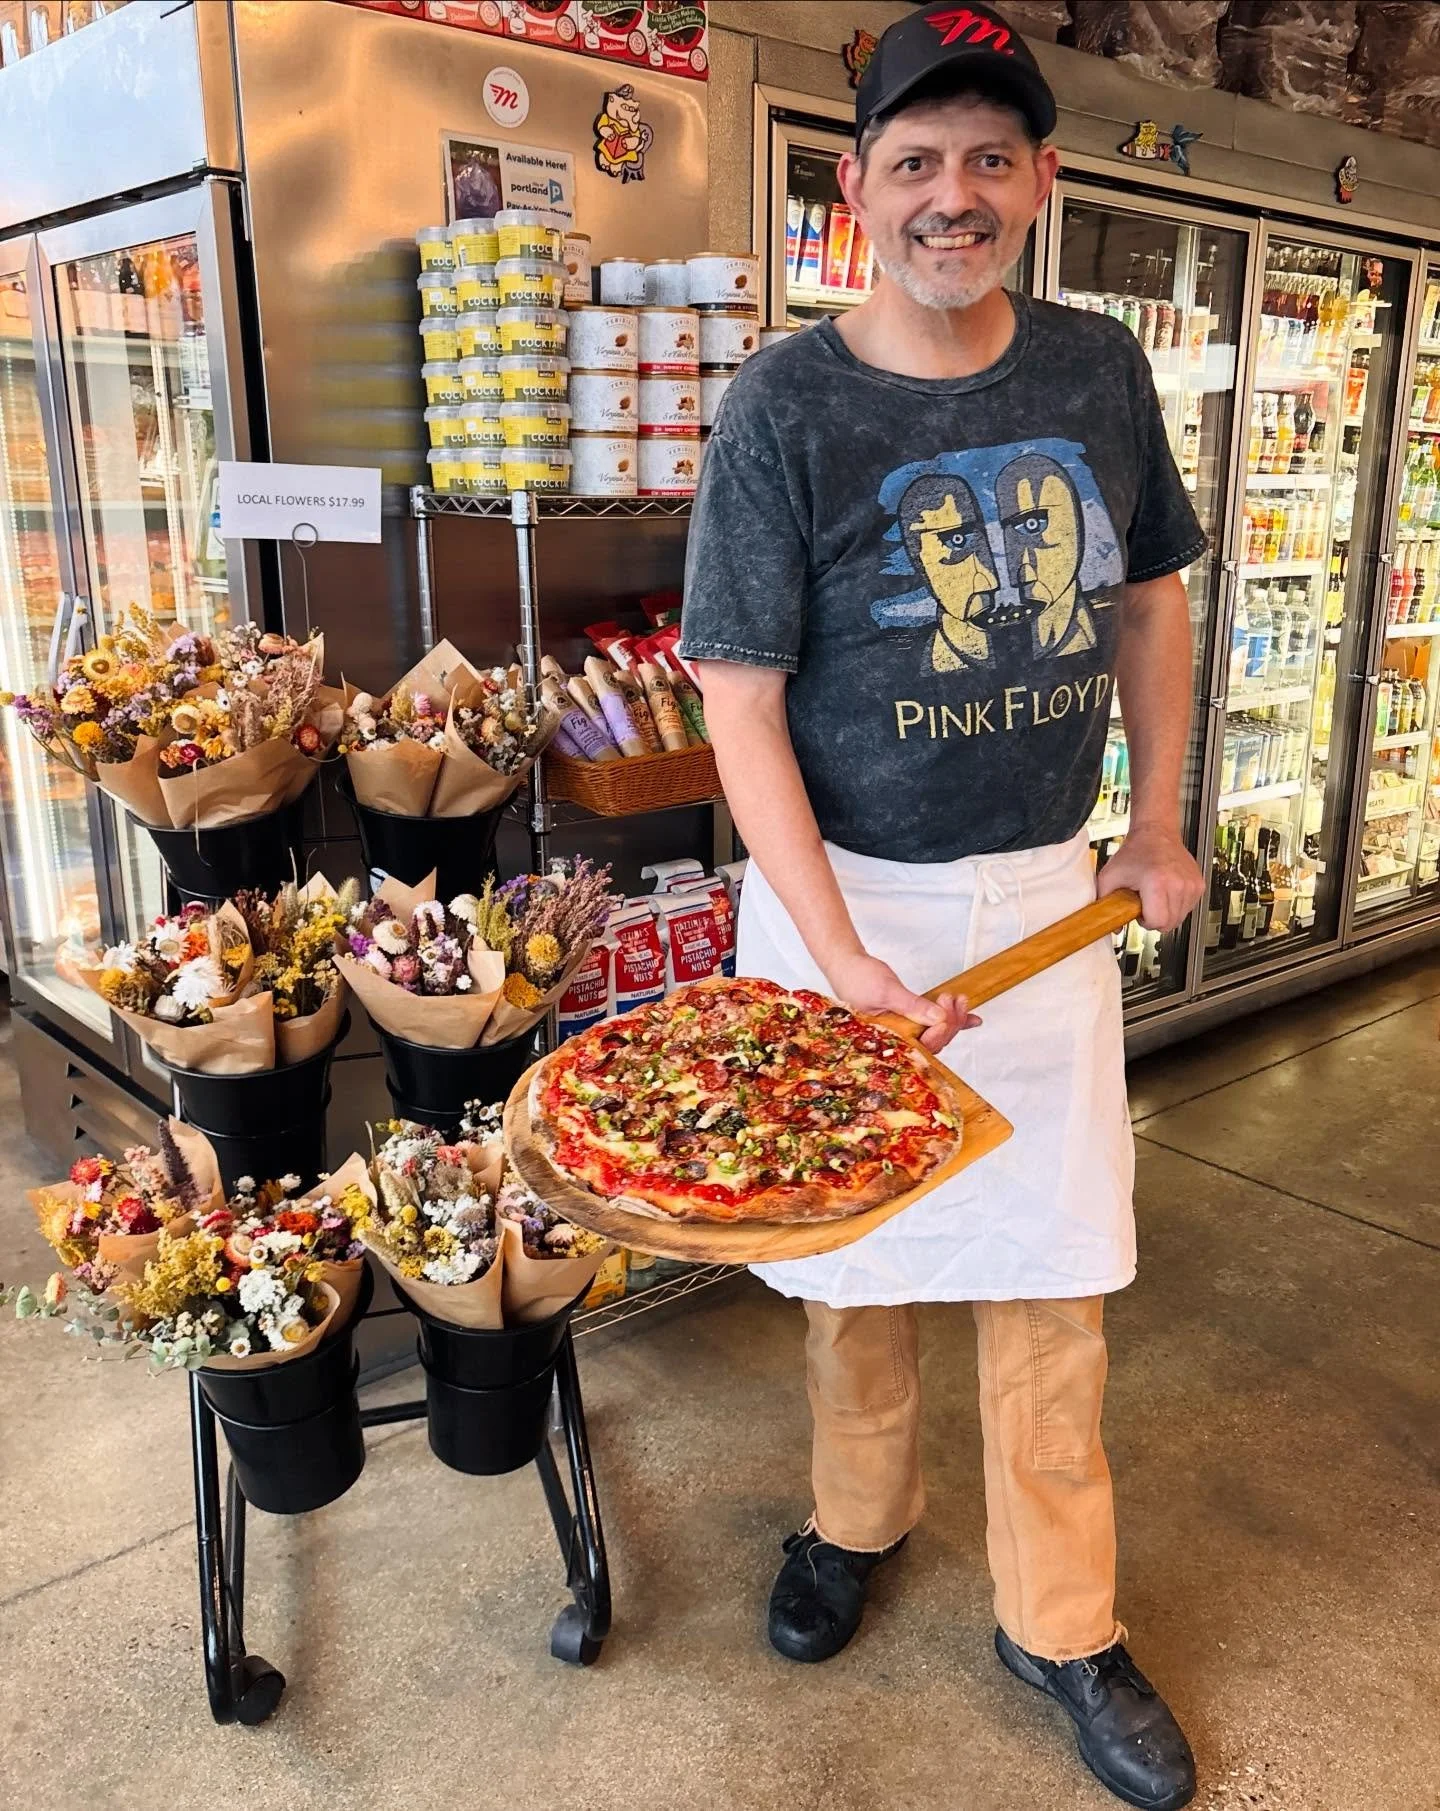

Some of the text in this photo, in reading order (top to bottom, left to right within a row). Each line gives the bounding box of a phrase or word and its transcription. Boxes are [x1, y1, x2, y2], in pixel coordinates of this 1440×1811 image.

[506, 153, 567, 171] Available Here!
[511, 183, 549, 195] portland
[467, 297, 500, 307] COCKT
[519, 339, 562, 350] COCKTAIL
[470, 387, 505, 396] COCKTA
[522, 387, 566, 397] COCKTAIL
[470, 432, 506, 441] COCKTA
[531, 432, 568, 442] COCKTA
[471, 478, 506, 488] COCKTA
[533, 479, 568, 489] COCKTA
[237, 494, 365, 508] LOCAL FLOWERS $17.99
[661, 697, 676, 711] Fig
[894, 673, 1110, 740] PINK FLOYD
[634, 707, 649, 721] Fig
[570, 716, 588, 730] Fig
[680, 947, 717, 965] PISTACHIO
[623, 958, 660, 974] PISTACHIO
[691, 960, 711, 973] NUTS
[633, 971, 654, 983] NUTS
[568, 977, 605, 995] PISTACHIO
[578, 990, 598, 1003] NUTS
